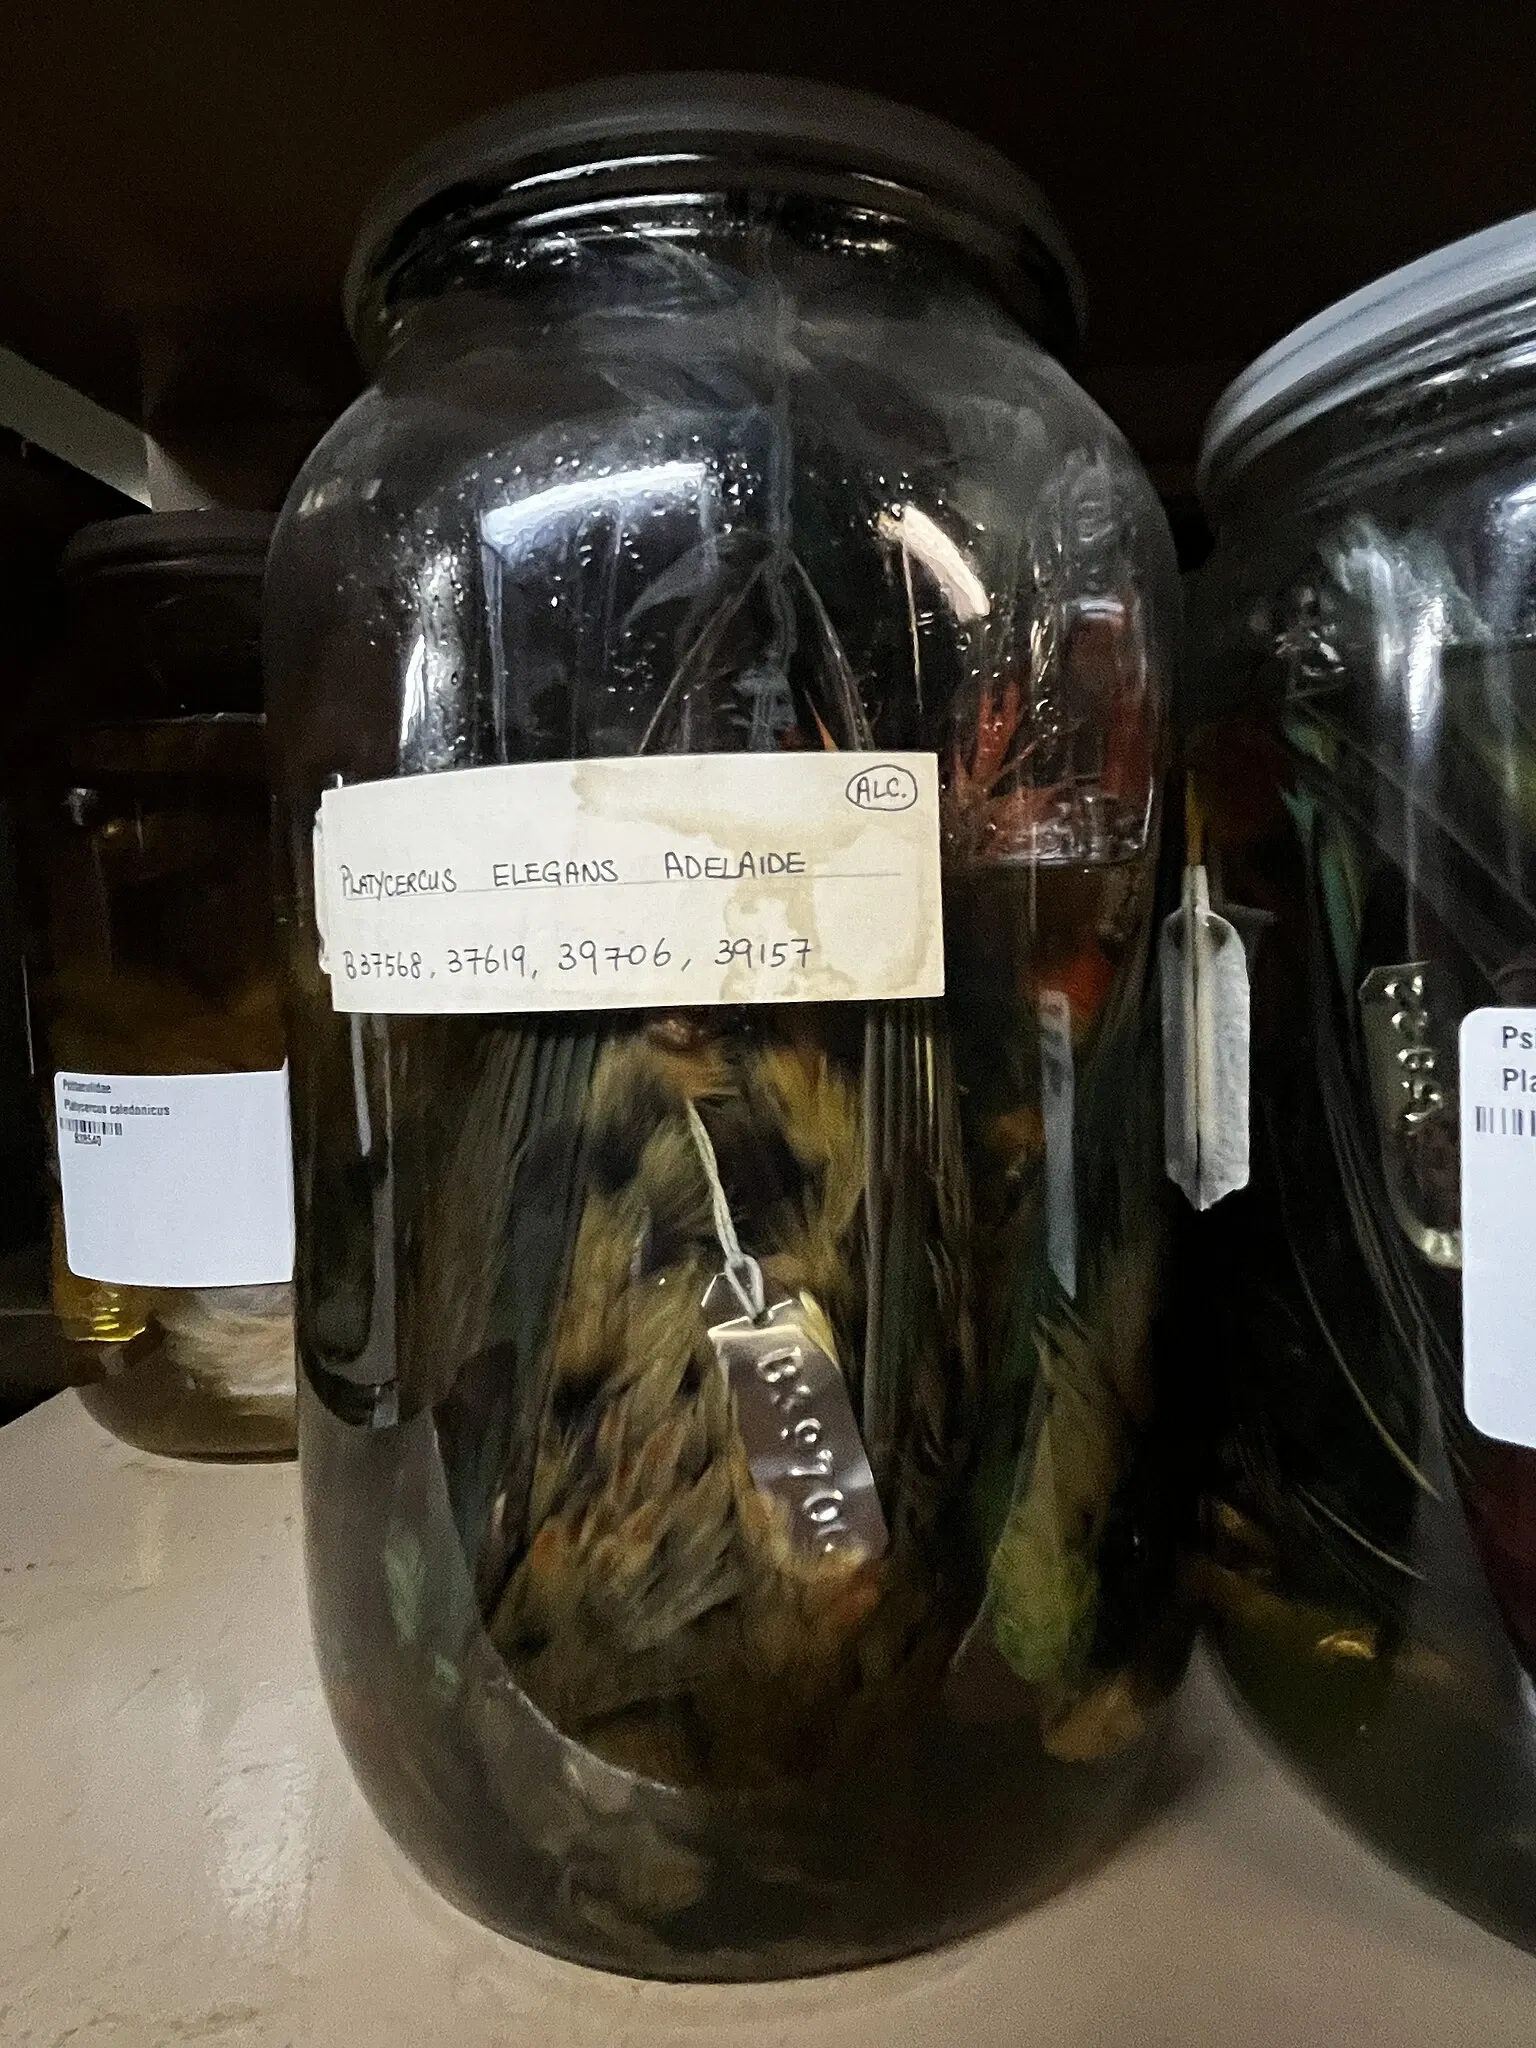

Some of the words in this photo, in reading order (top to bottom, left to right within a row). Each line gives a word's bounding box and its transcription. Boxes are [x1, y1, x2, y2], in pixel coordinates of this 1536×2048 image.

[855, 779, 907, 802] ALC.
[340, 864, 457, 897] PLATYCERCUS
[493, 859, 619, 889] ELEGANS
[665, 851, 806, 880] ADELAIDE
[447, 943, 538, 979] 37619,
[714, 937, 812, 968] 39157
[1502, 1026, 1536, 1049] Ps
